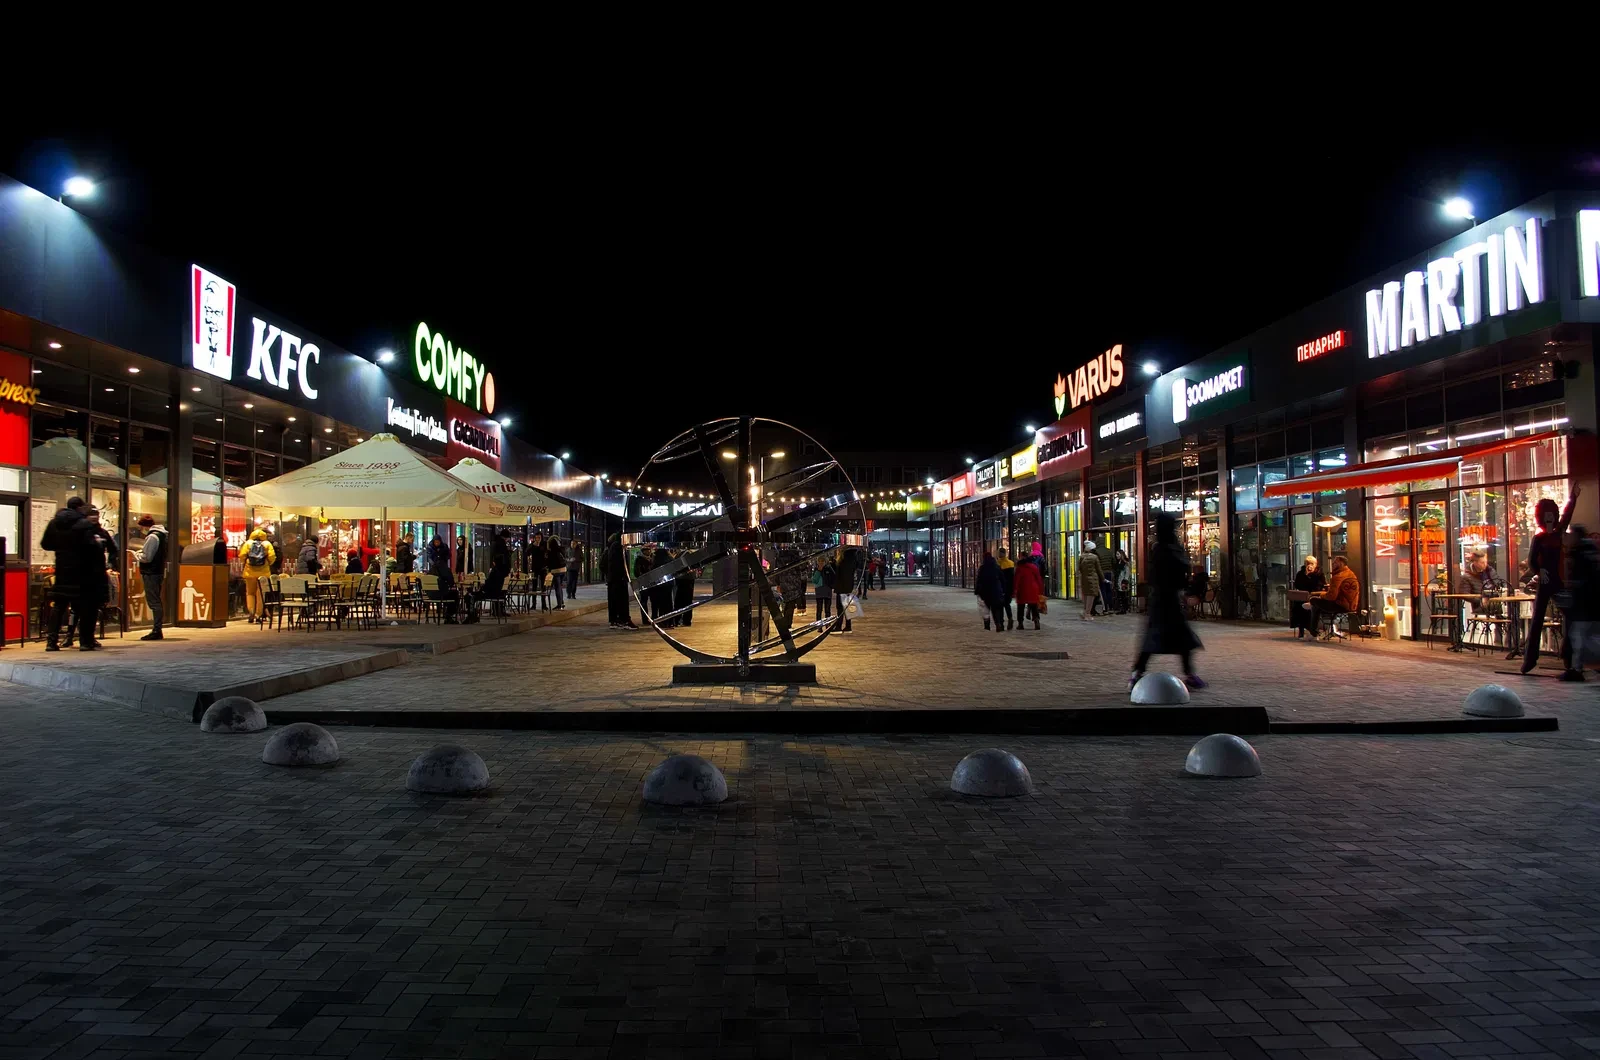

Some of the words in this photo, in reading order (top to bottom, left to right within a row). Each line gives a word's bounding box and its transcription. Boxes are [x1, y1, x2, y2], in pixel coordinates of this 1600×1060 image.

[1365, 218, 1545, 359] MARTIN
[246, 316, 321, 400] KFC
[414, 321, 485, 411] COMFY
[1297, 330, 1343, 362] ПЕКАРНЯ
[1066, 343, 1124, 409] VARUS
[1186, 365, 1244, 407] ЗООМАРКЕТ
[334, 461, 364, 470] Since
[364, 461, 400, 470] 1988
[506, 503, 525, 512] Since
[526, 505, 548, 515] 1988
